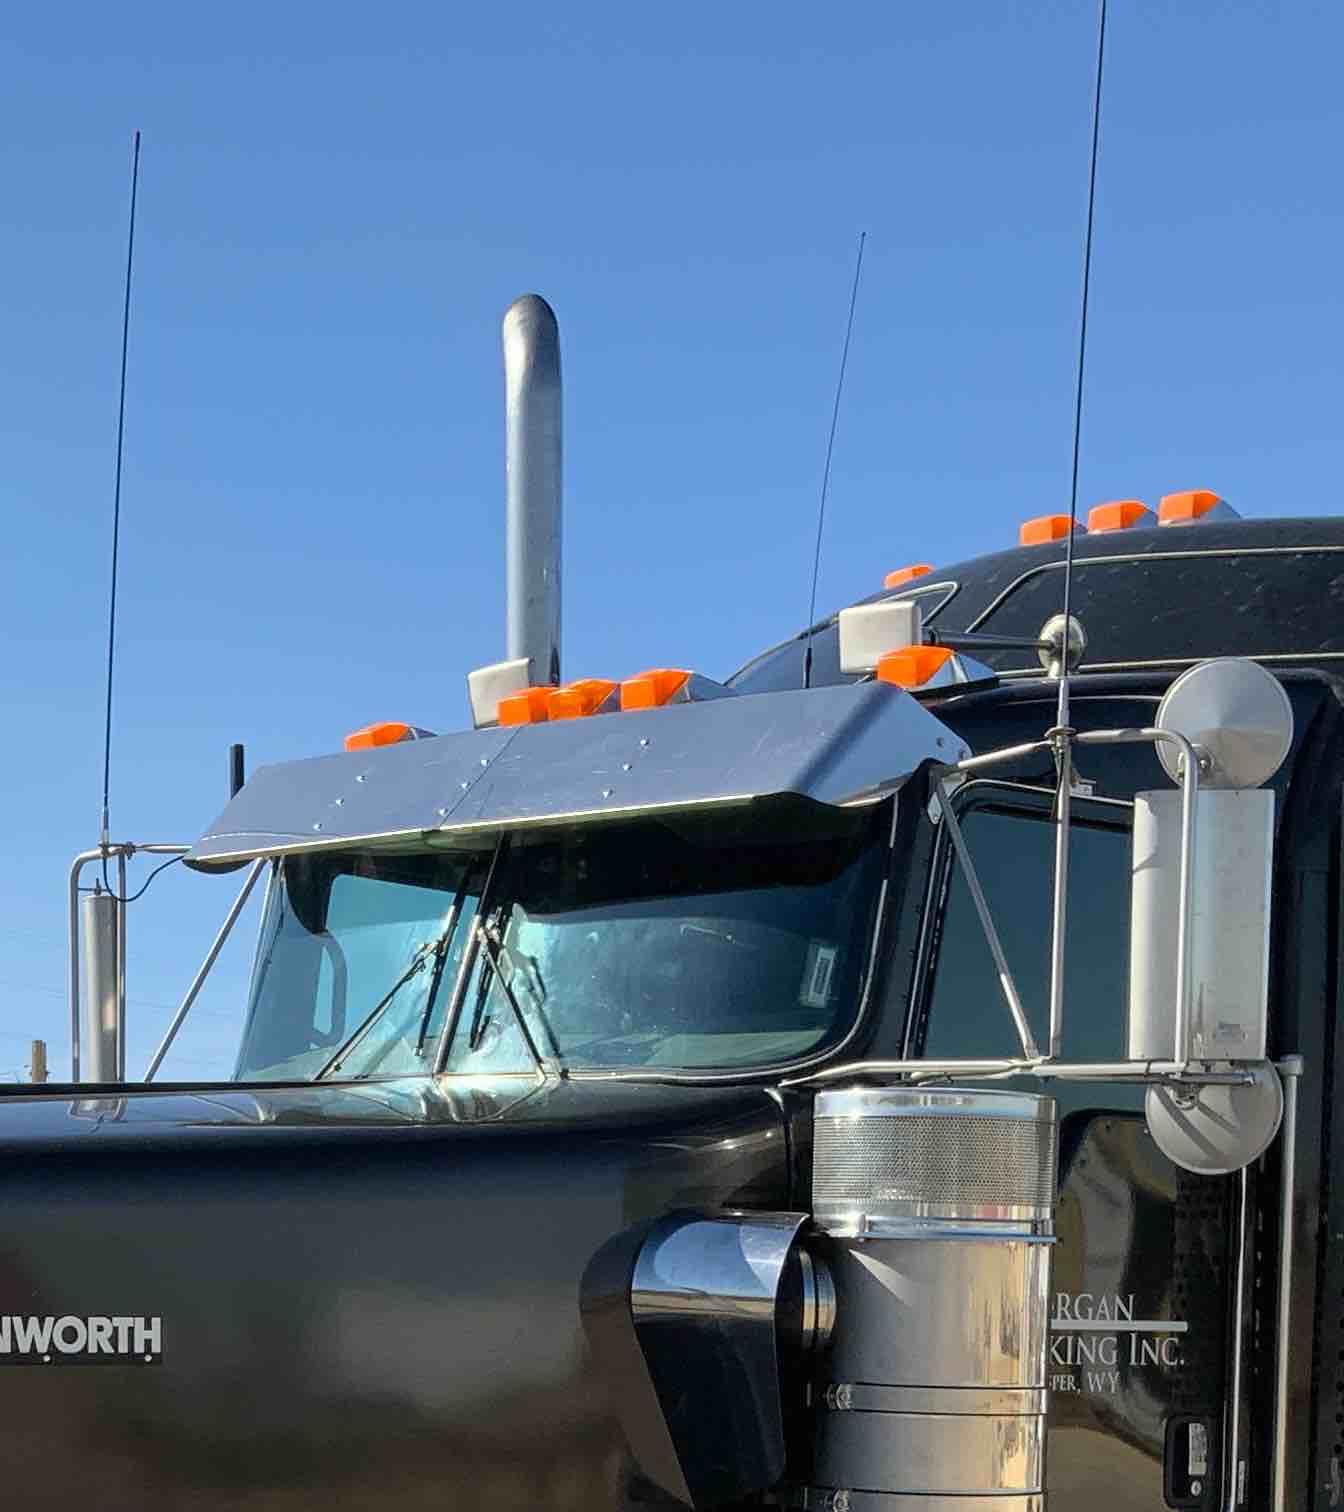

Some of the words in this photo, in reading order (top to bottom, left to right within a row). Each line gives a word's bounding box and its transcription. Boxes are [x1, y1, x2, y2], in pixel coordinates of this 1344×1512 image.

[1051, 1293, 1136, 1321] RGAN
[1129, 1332, 1186, 1367] INC.
[1049, 1374, 1081, 1395] PER,
[1087, 1371, 1121, 1393] WY
